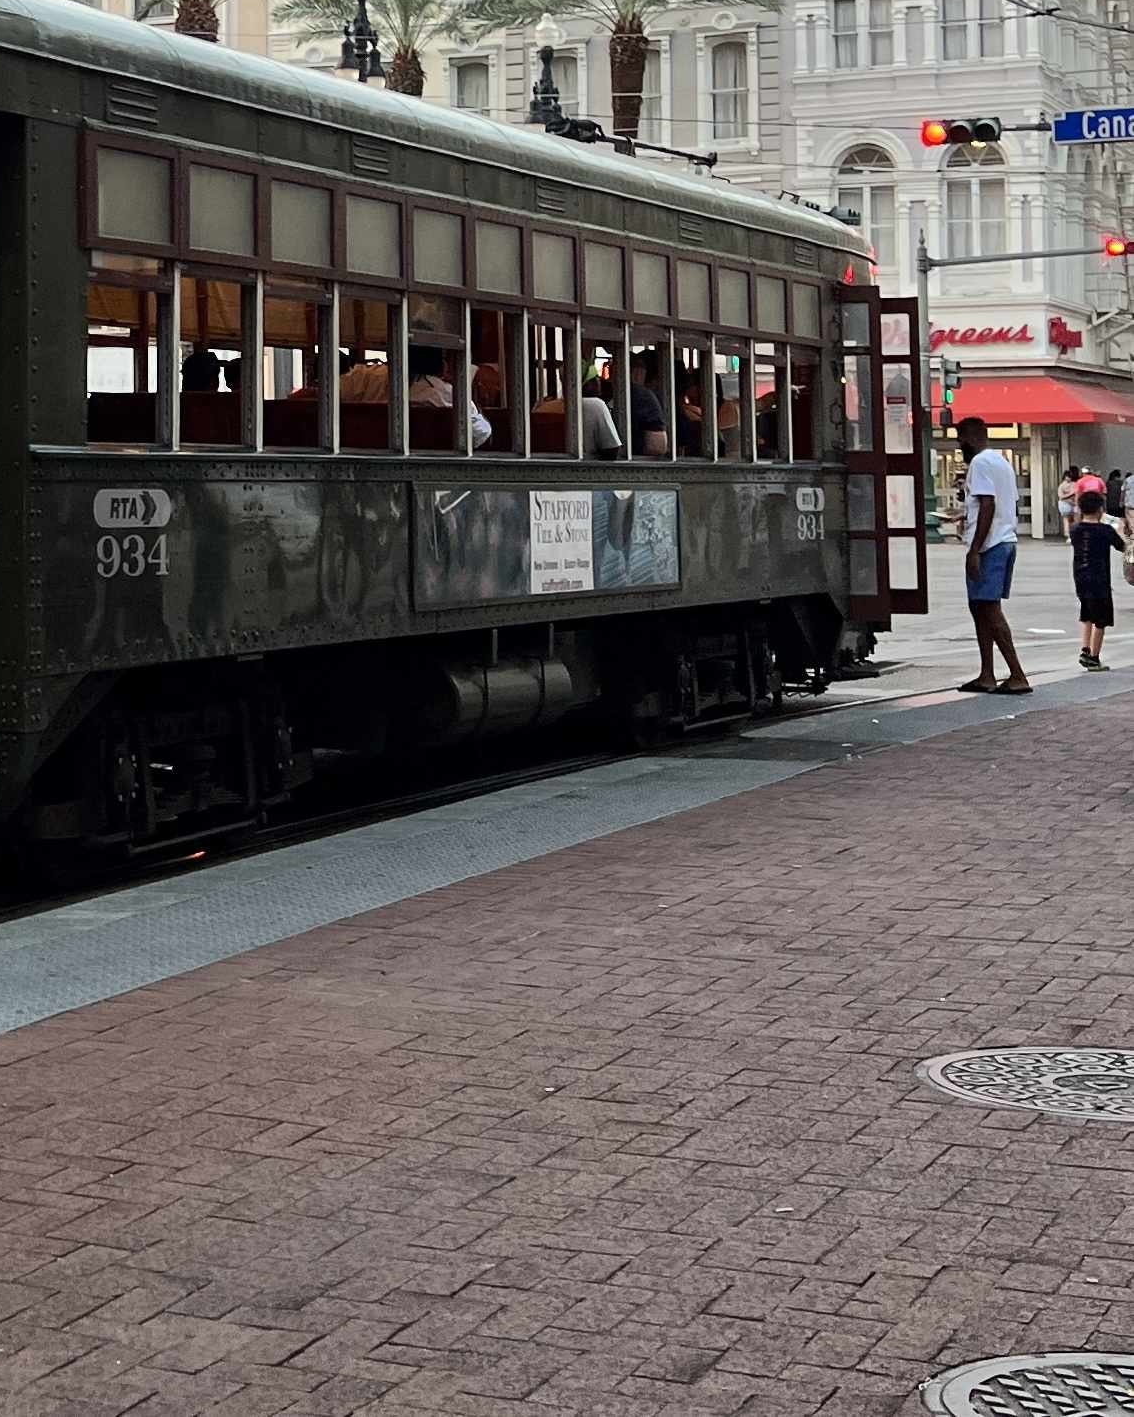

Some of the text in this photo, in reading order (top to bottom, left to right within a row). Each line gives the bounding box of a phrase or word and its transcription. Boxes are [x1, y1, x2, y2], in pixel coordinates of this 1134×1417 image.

[110, 497, 138, 519] RTA
[533, 491, 590, 521] STAFFORD
[554, 524, 563, 544] &
[797, 513, 825, 540] 934
[96, 533, 170, 578] 934
